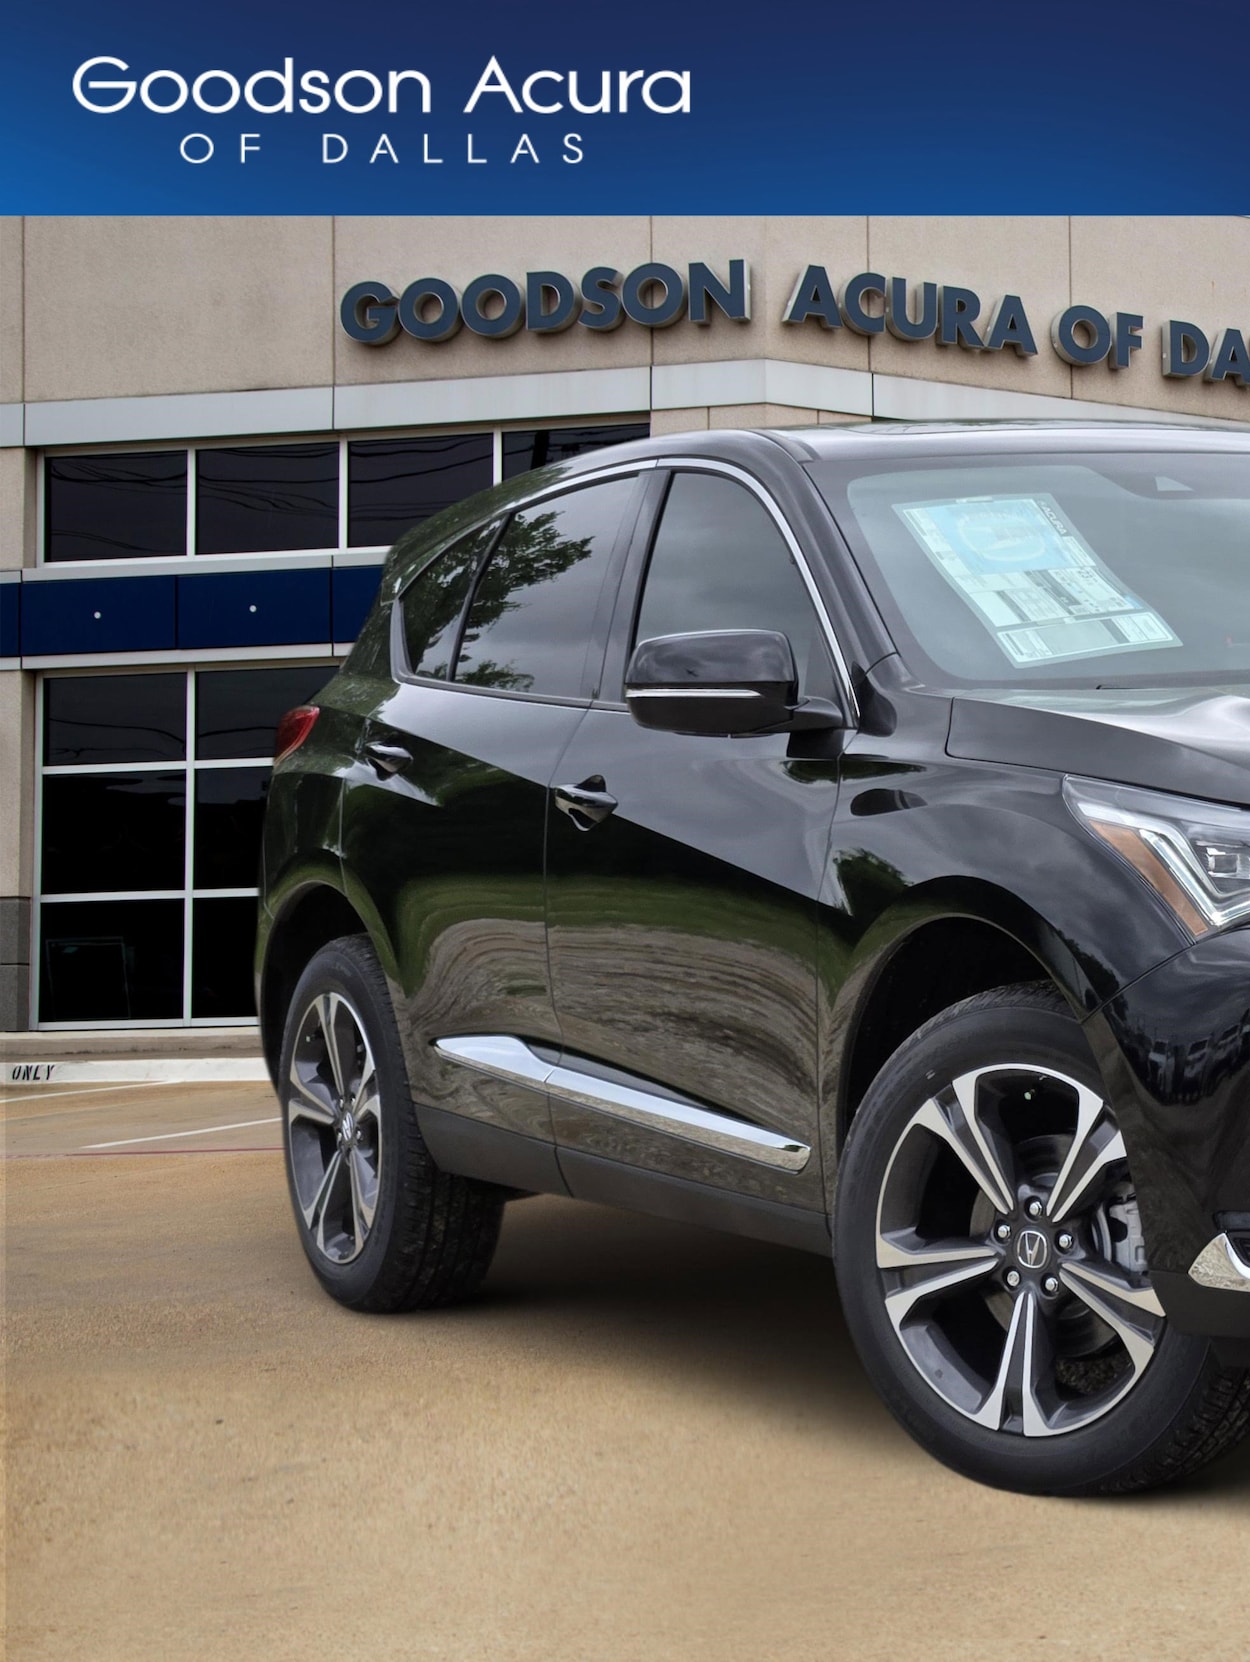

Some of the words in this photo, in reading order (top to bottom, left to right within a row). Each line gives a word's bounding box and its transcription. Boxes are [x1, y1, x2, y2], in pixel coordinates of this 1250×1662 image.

[340, 259, 751, 345] GOODSON
[783, 264, 1038, 357] ACURA
[1051, 305, 1143, 369] OF
[1041, 506, 1067, 534] ACURA
[12, 1064, 55, 1081] ONLY
